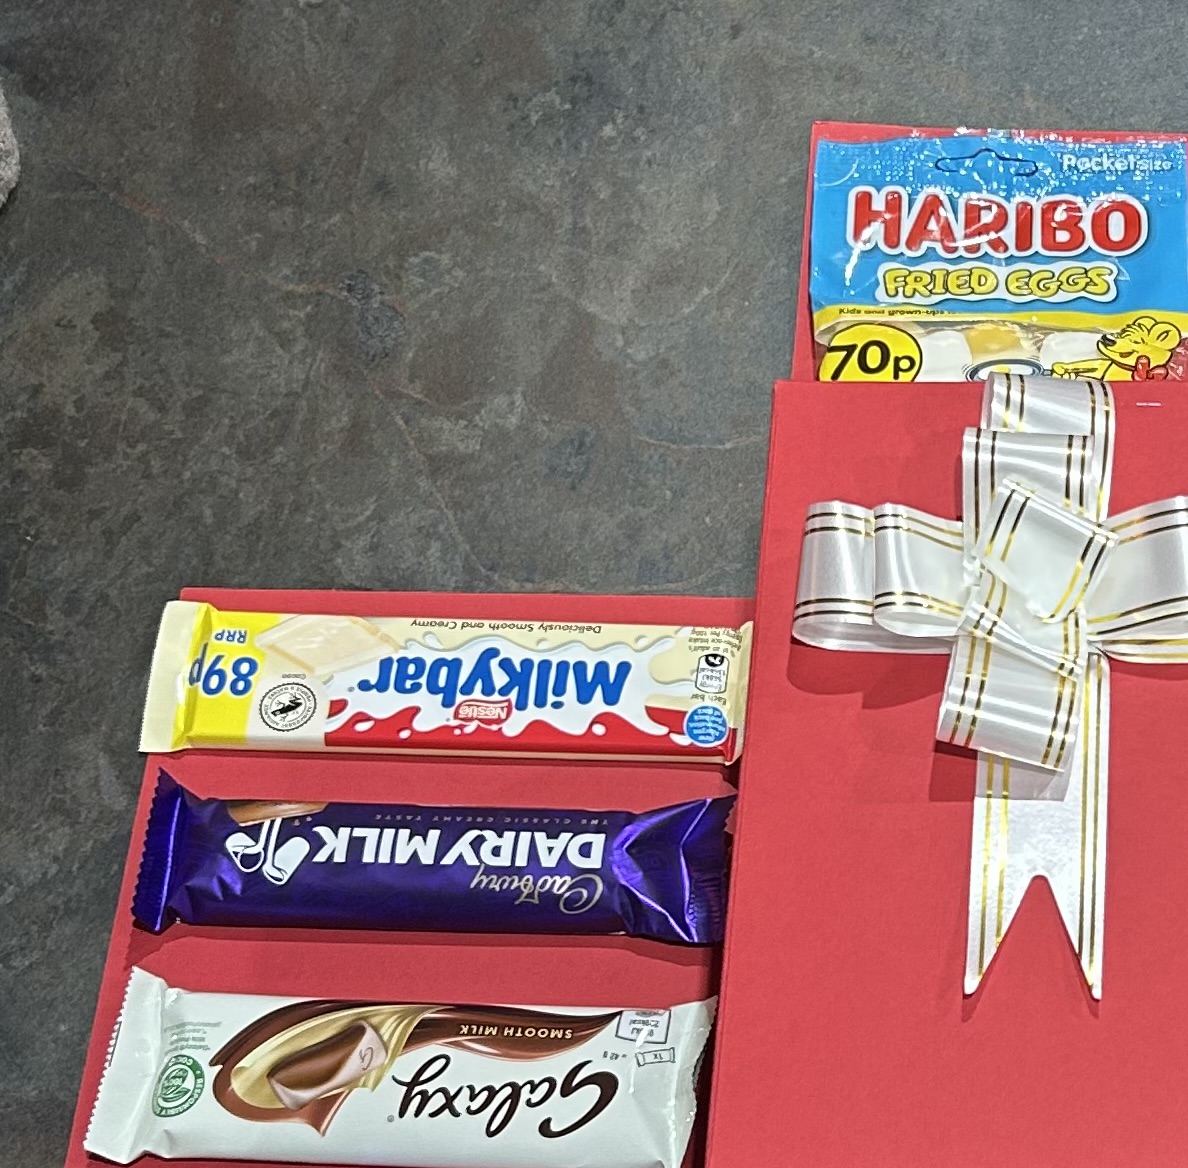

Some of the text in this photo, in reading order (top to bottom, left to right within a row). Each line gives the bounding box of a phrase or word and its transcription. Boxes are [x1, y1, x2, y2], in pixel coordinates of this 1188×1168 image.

[850, 187, 1147, 256] HARIBO
[883, 266, 1115, 298] FRIED EGGS
[827, 340, 916, 381] 70p
[214, 630, 247, 644] RRP
[411, 618, 602, 634] Deliciously Smooth and Creamy
[189, 643, 259, 696] 89p
[358, 648, 632, 711] Milkybar
[312, 827, 607, 869] DAIRY MILK
[470, 863, 603, 914] Cadbury
[458, 1023, 574, 1039] SMOOTH MILK
[392, 1054, 619, 1138] Galaxy
